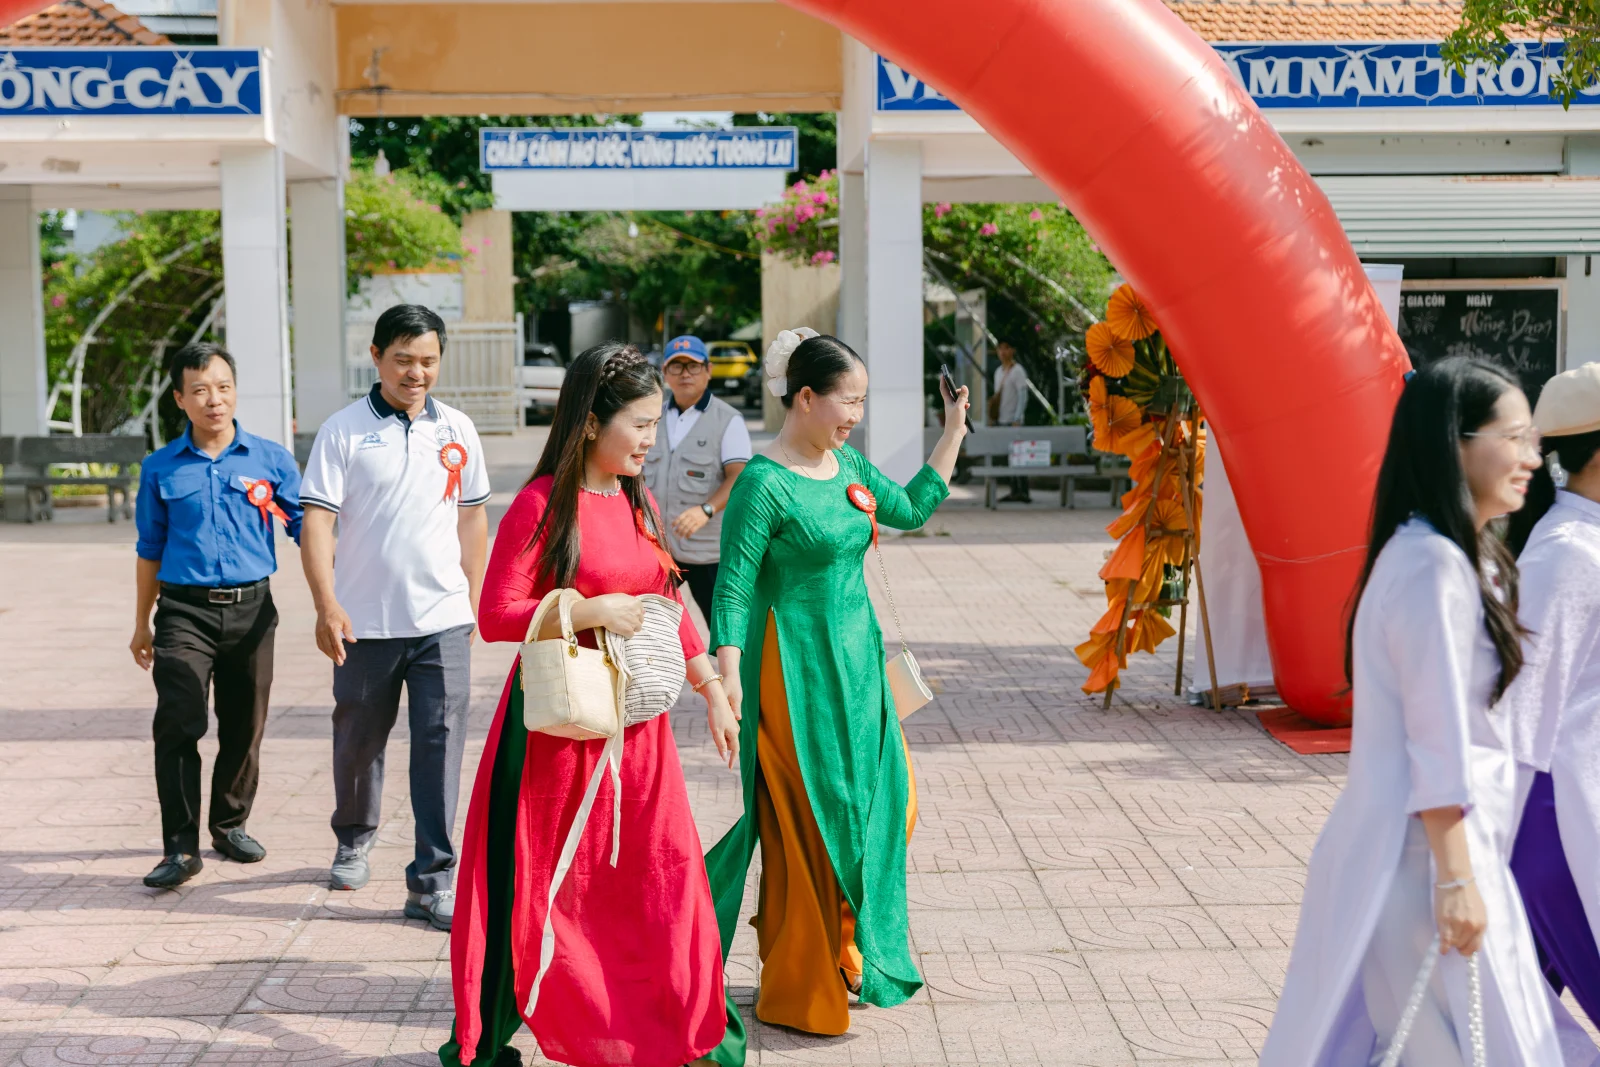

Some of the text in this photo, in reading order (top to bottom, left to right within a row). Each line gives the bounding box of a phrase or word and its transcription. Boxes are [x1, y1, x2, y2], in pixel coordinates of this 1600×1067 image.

[1300, 50, 1417, 97] NĂM
[766, 139, 792, 165] LAI
[1407, 295, 1424, 308] GIA
